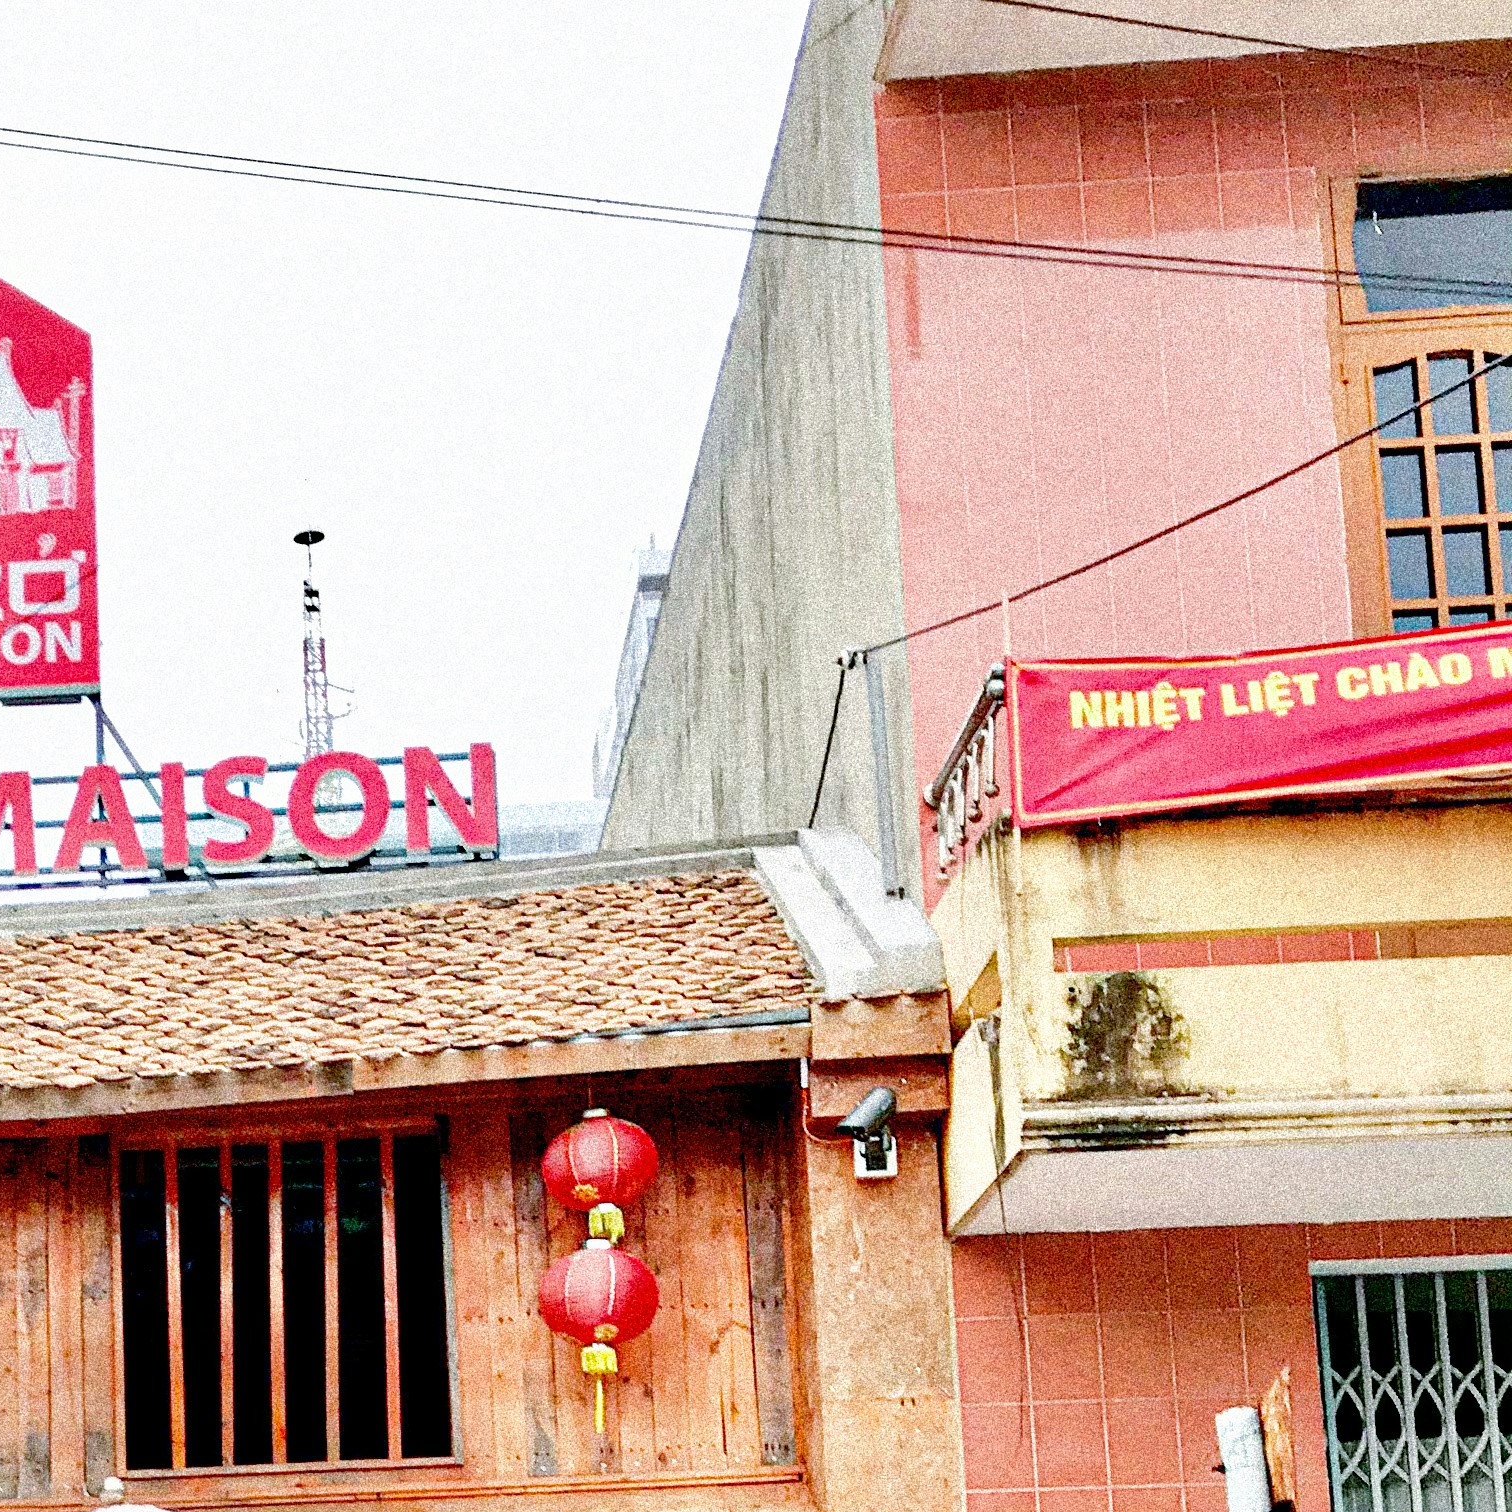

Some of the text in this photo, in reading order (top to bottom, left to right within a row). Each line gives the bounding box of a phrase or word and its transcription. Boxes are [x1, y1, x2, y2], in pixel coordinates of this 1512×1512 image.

[1069, 681, 1205, 731] NHIỆT
[1220, 670, 1319, 718] LIỆT
[1336, 652, 1474, 699] CHÀO
